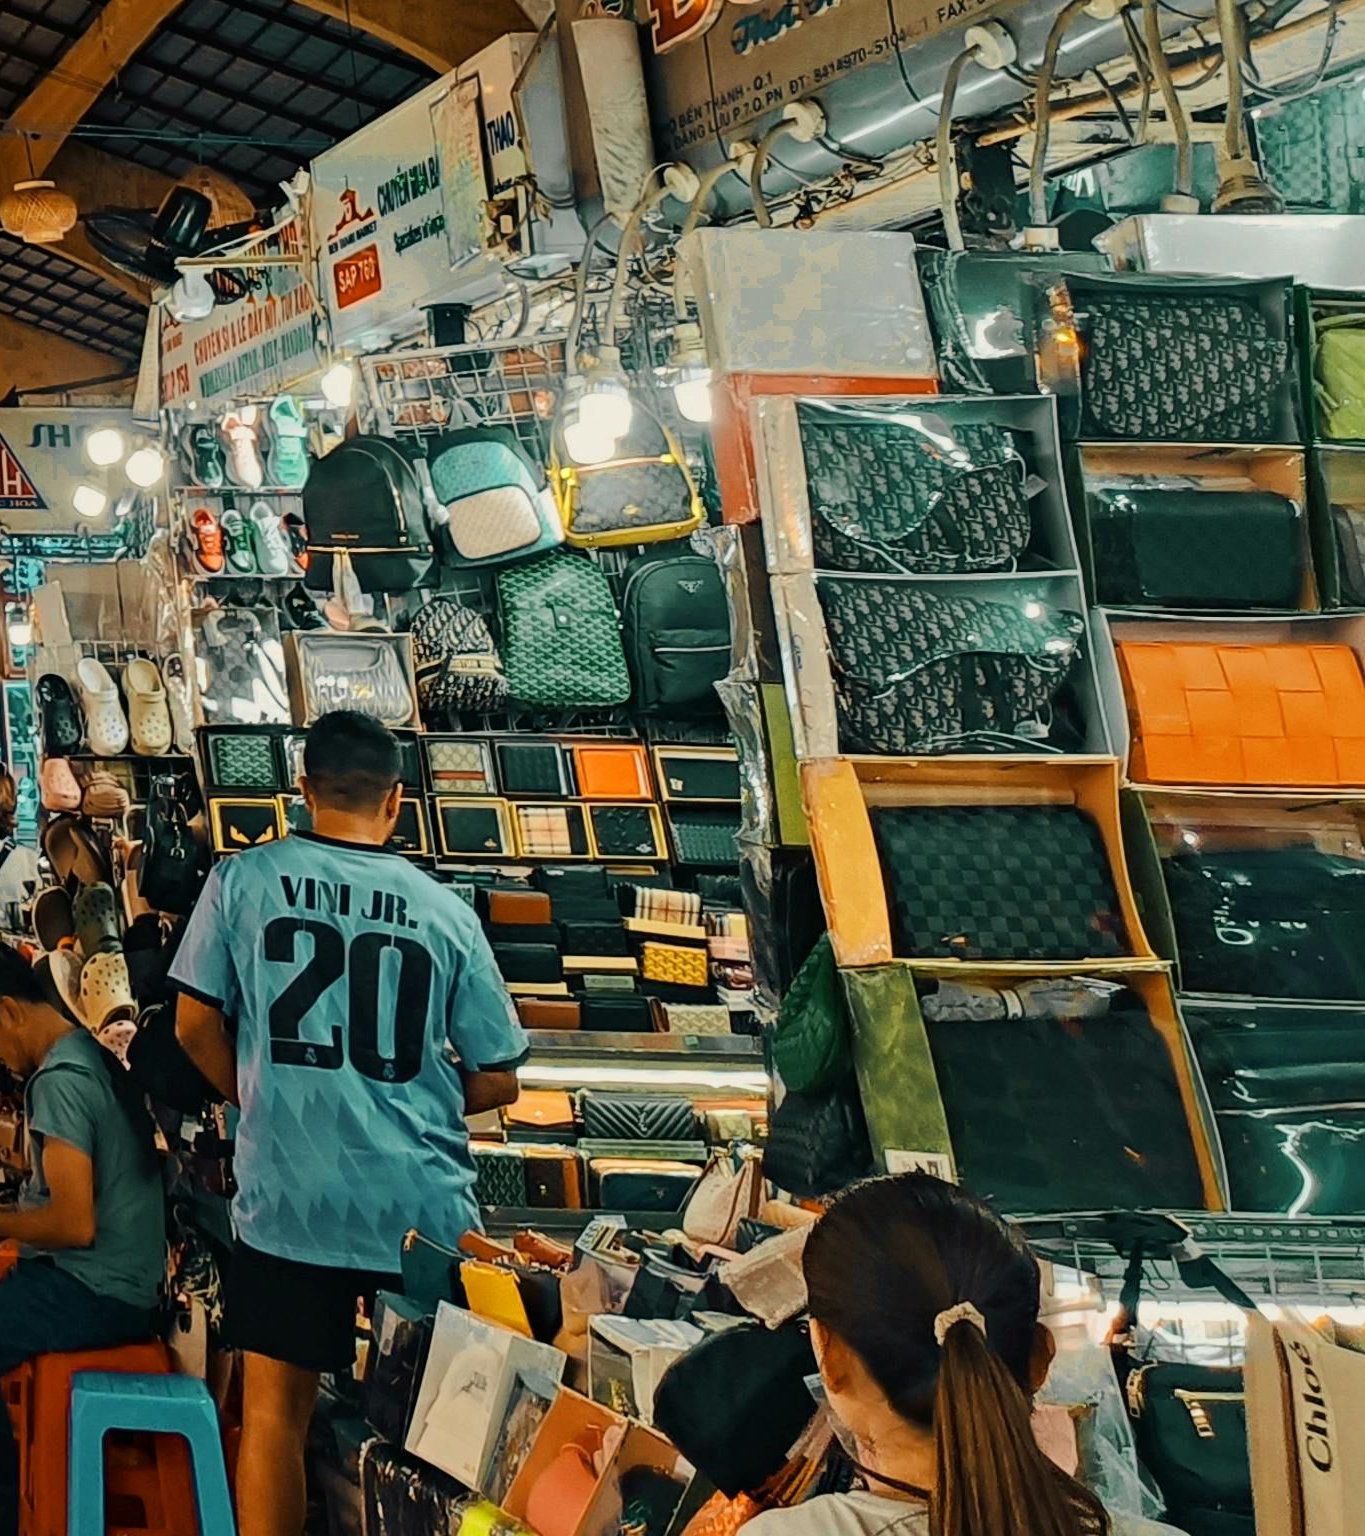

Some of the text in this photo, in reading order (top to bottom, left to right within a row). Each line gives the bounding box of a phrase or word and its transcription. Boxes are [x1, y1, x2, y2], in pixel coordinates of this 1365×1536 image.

[280, 874, 419, 929] VINI JR.
[263, 916, 434, 1084] 20
